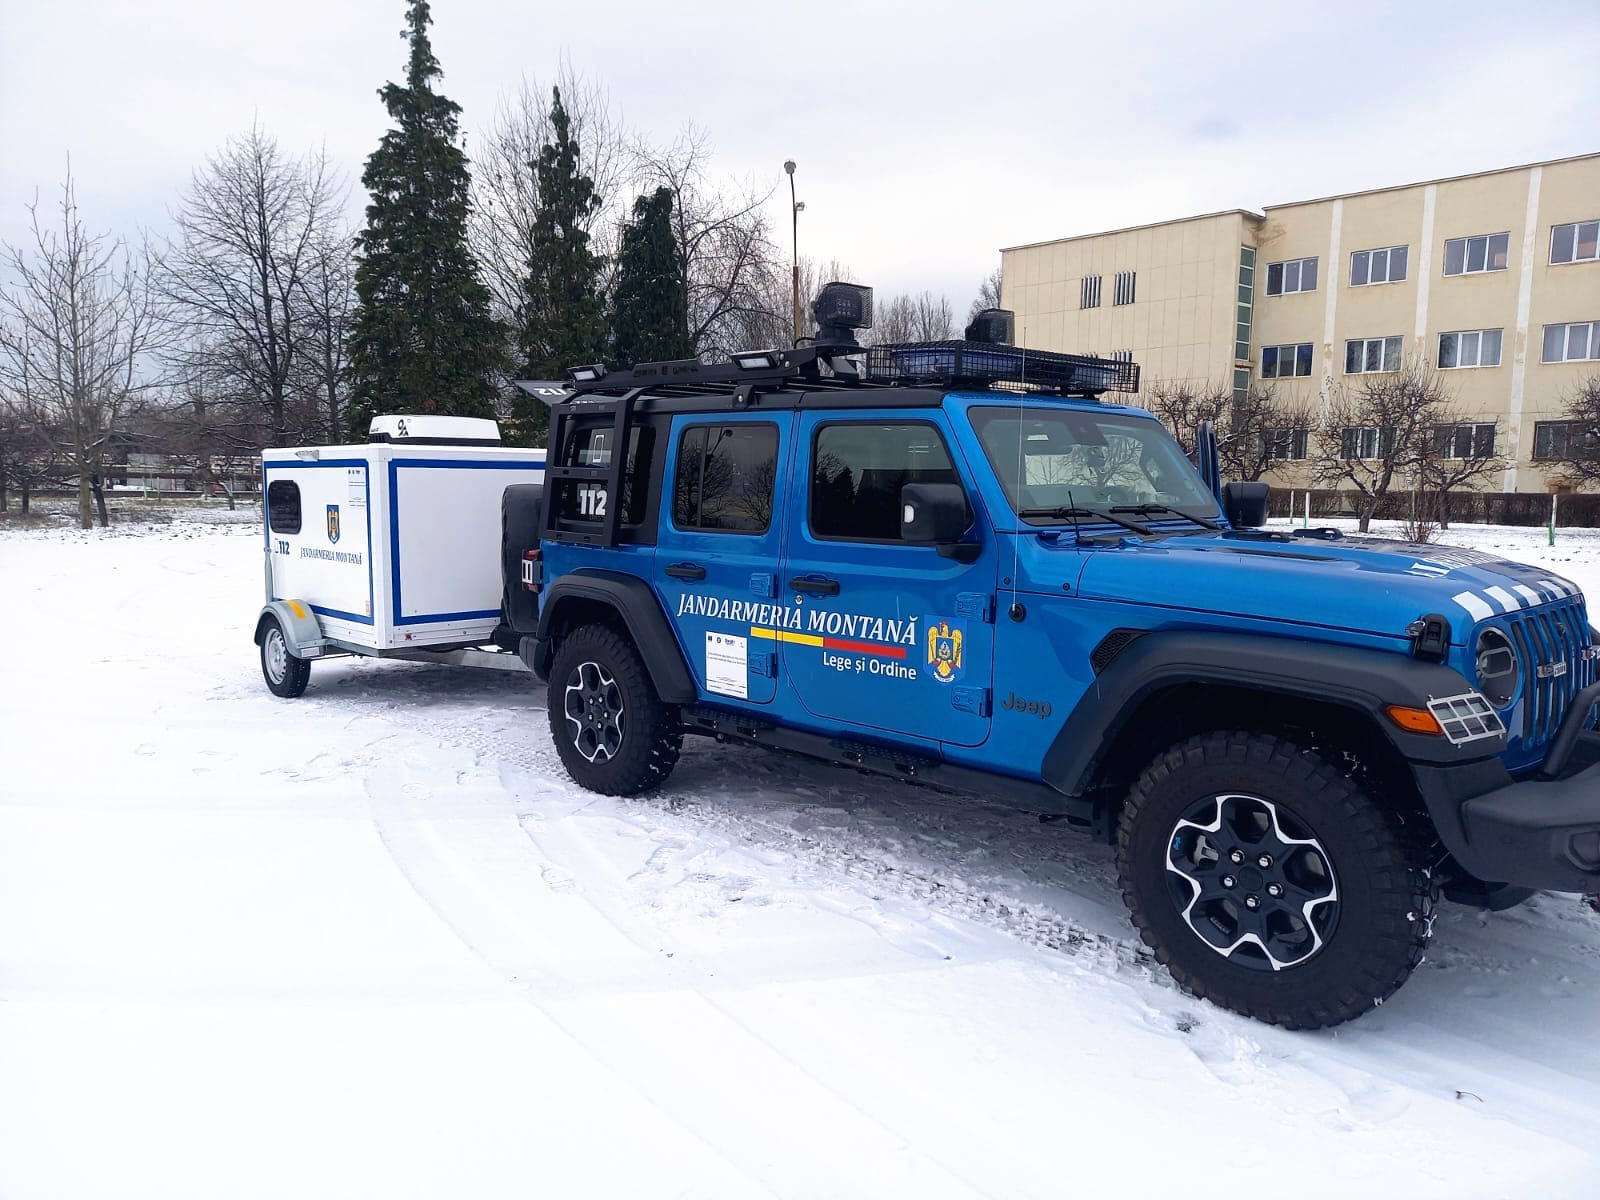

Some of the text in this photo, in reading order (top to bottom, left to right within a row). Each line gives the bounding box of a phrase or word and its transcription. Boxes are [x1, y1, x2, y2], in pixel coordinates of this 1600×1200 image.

[580, 489, 608, 516] 112
[278, 540, 290, 555] 112
[300, 547, 335, 561] JANDARMERIA
[676, 593, 918, 645] JANDARMERIA MONTANĂ
[823, 651, 852, 671] Lege
[855, 657, 866, 675] și
[869, 659, 917, 680] Ordine
[1001, 691, 1052, 720] Jeep
